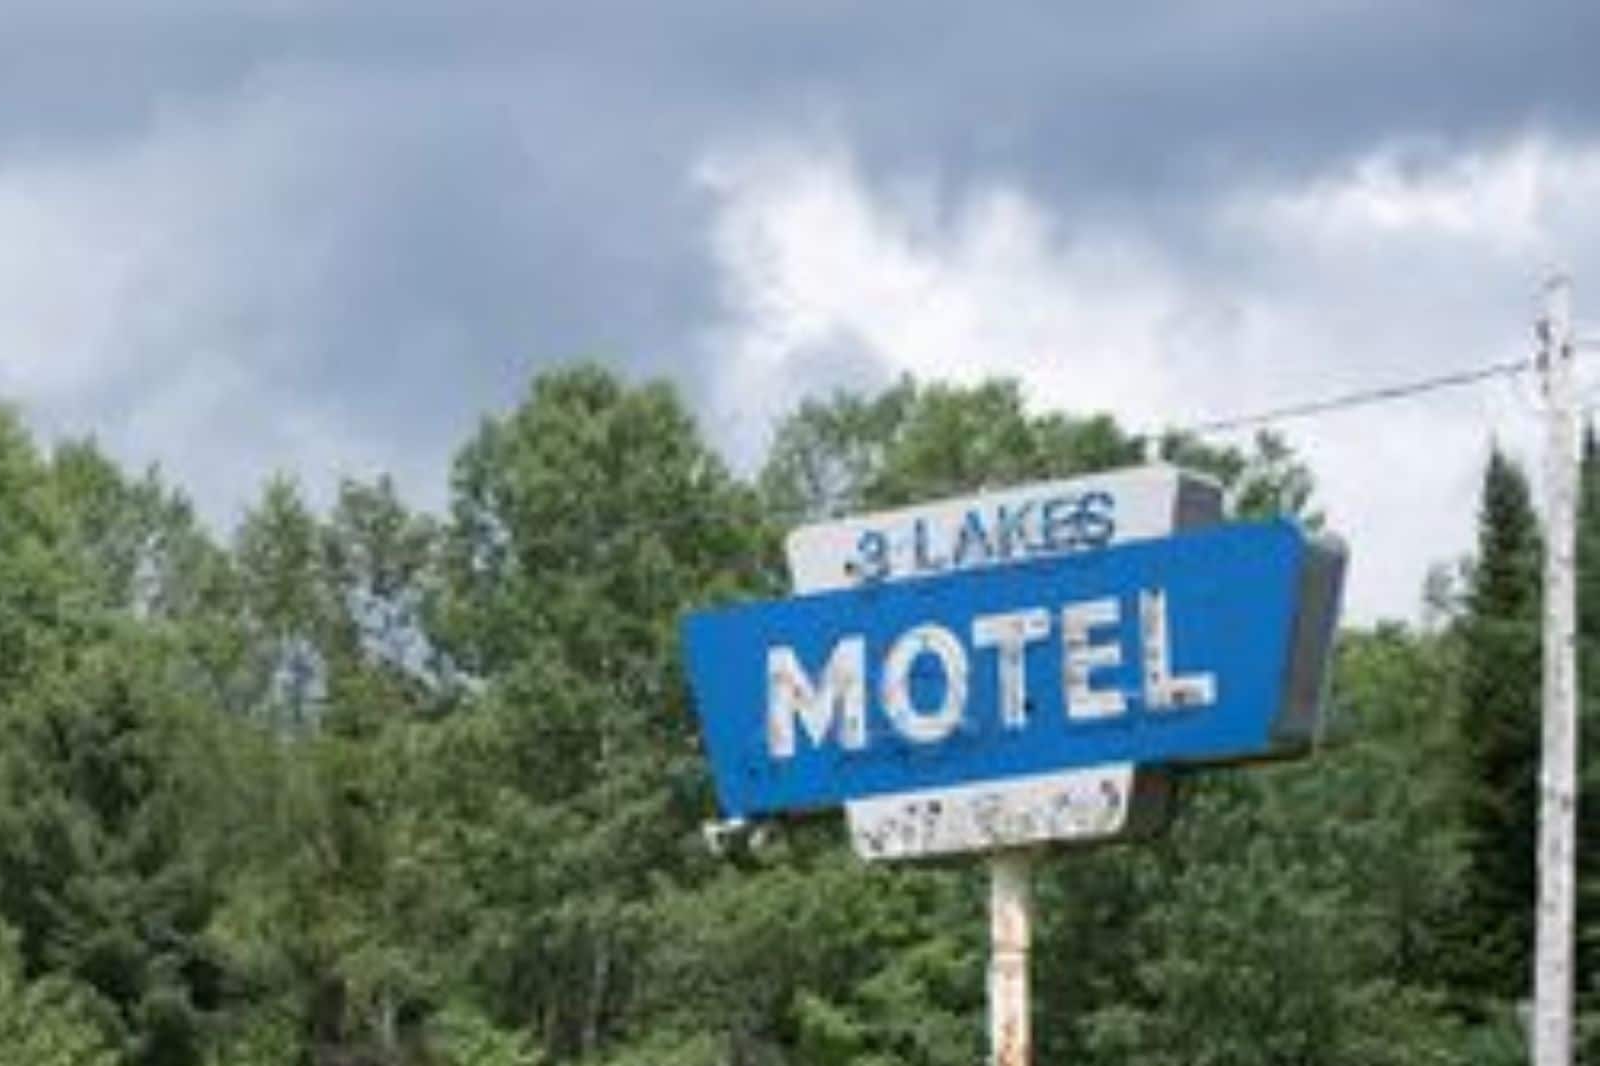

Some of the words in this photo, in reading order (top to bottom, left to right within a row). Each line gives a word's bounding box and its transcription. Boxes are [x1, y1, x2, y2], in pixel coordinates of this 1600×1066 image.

[856, 530, 891, 584] 3
[914, 490, 1117, 572] LAKES
[767, 588, 1218, 758] MOTEL
